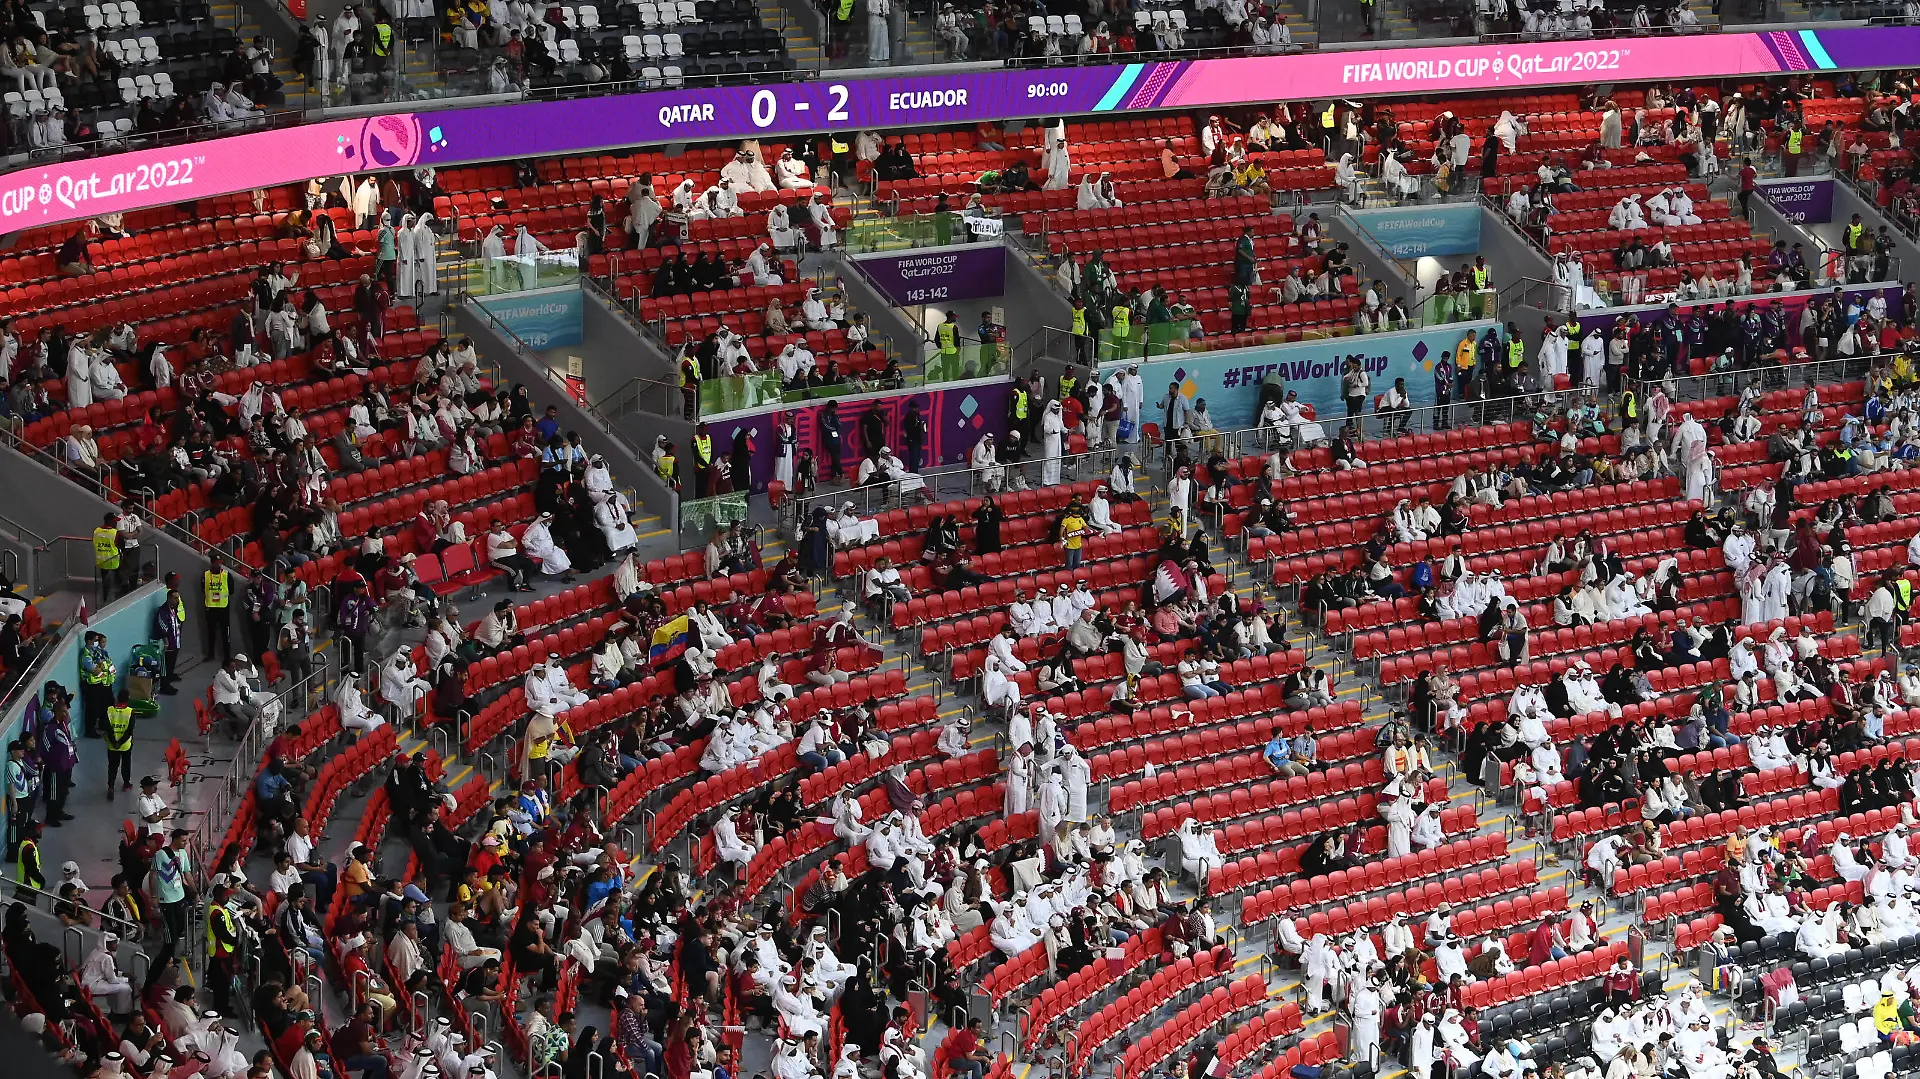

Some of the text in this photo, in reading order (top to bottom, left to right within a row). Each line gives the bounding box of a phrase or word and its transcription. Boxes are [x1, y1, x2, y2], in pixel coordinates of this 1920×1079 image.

[1343, 63, 1383, 84] FIFA
[1385, 60, 1451, 81] WORLD
[1454, 58, 1489, 77] CUP
[658, 103, 715, 127] QATAR
[751, 89, 777, 127] 0
[827, 84, 849, 121] 2
[889, 89, 968, 110] ECUADOR
[1027, 82, 1068, 98] 90:00
[1767, 187, 1781, 195] FIFA
[1781, 185, 1802, 194] WORLD
[2, 186, 35, 216] CUP
[1376, 217, 1446, 230] #FIFAWorldCup
[1393, 243, 1427, 255] 142-141
[898, 255, 958, 269] FIFA WORLD CUP
[906, 286, 948, 301] 143-142
